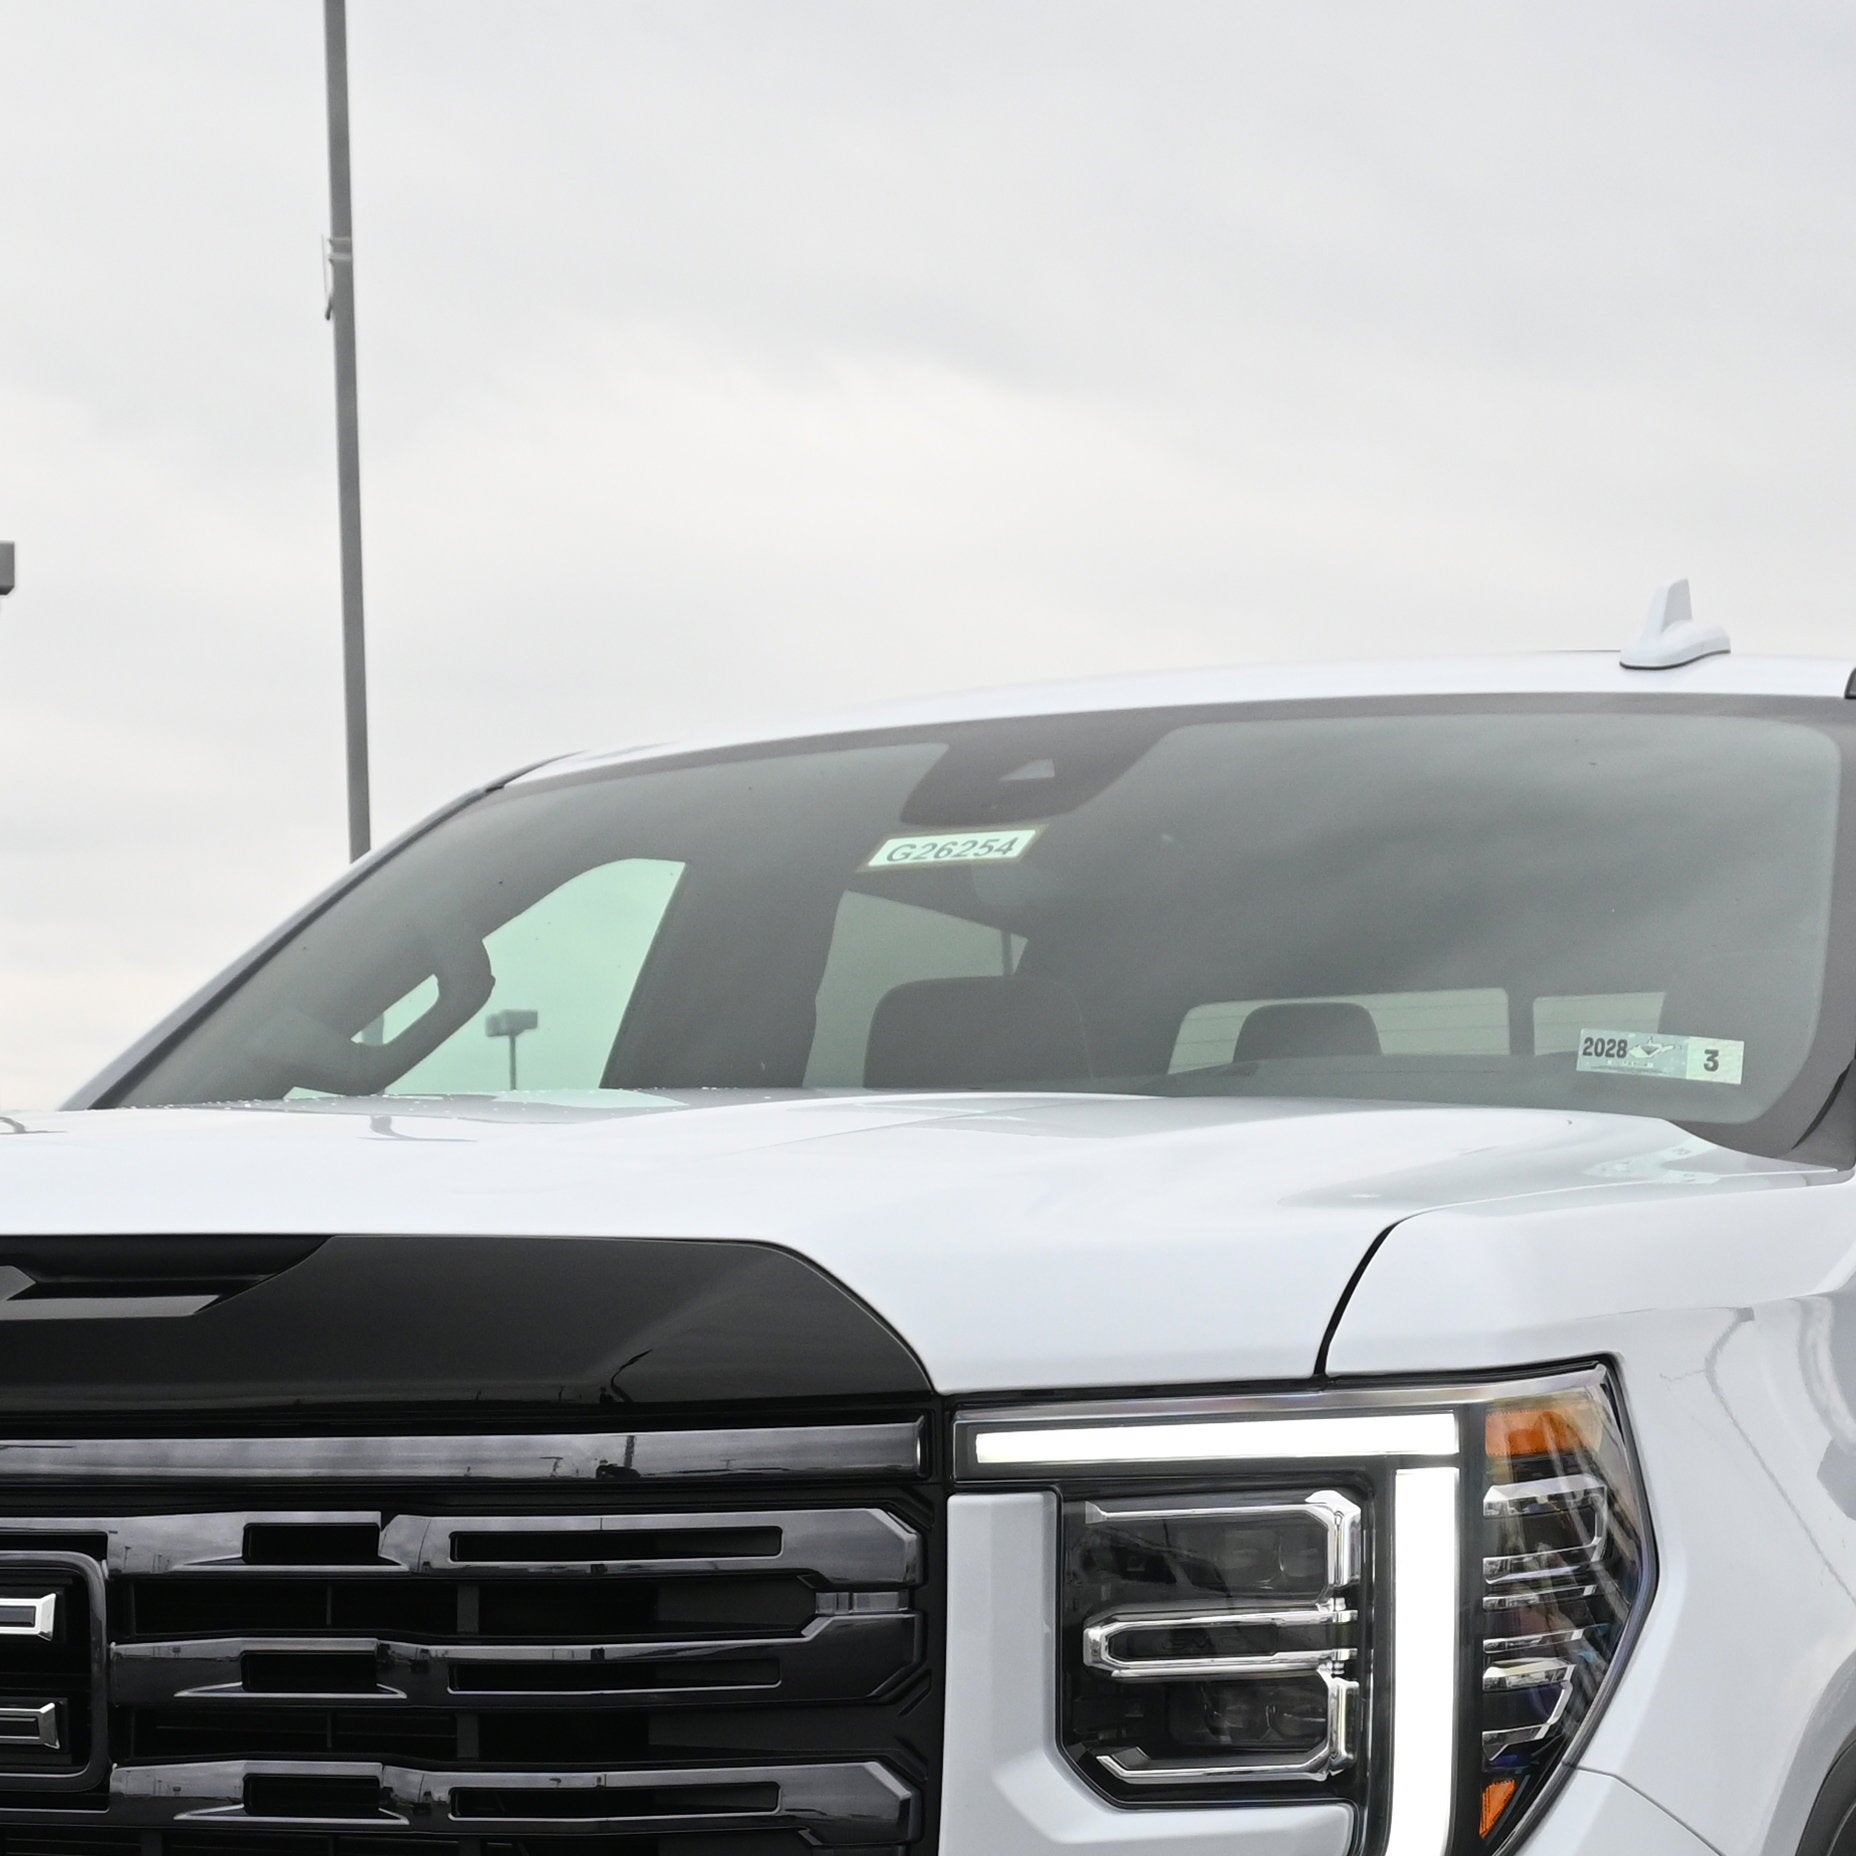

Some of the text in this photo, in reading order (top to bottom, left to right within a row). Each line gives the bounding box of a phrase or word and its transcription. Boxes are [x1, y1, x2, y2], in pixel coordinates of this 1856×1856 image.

[886, 836, 1019, 862] G26254
[1582, 1037, 1628, 1059] 2028
[1703, 1049, 1720, 1072] 3
